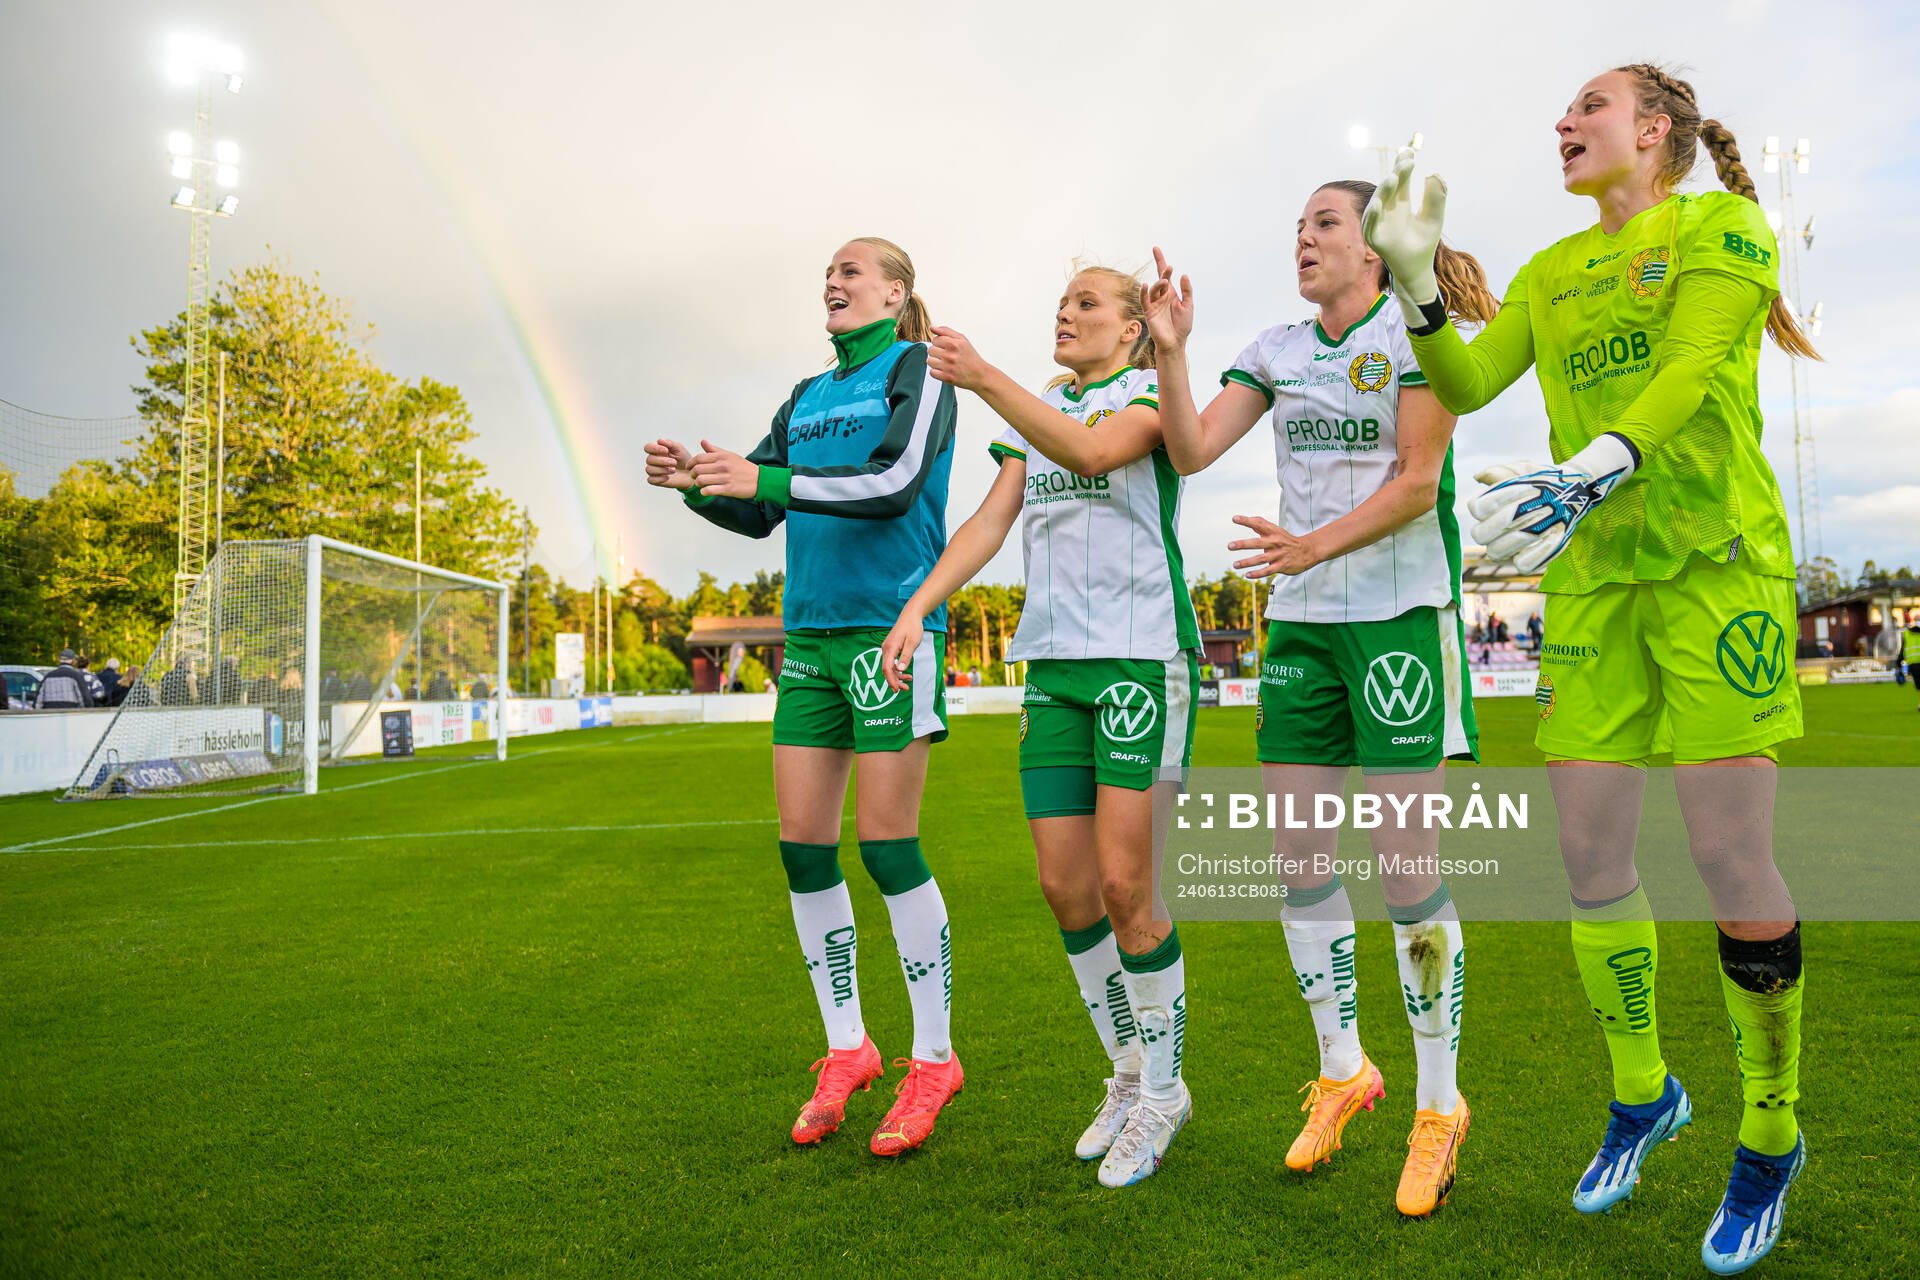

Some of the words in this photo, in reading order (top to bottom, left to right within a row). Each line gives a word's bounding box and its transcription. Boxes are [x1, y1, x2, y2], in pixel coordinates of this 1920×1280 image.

[1723, 232, 1771, 266] BST
[1564, 330, 1651, 381] ROJOB
[1315, 371, 1339, 381] NORDIC
[1603, 360, 1651, 380] WORKWEAR
[788, 416, 845, 447] CRAFT
[1286, 418, 1380, 443] PROJOB
[1292, 443, 1339, 452] PROFESSIONAL
[1026, 494, 1074, 506] PROFESSIONAL
[1074, 492, 1111, 501] WORKWEAR
[1541, 642, 1599, 657] SPHORUS
[864, 718, 895, 727] CRAFT
[1753, 704, 1779, 723] CRAFT
[204, 729, 262, 751] hässleholm
[1391, 735, 1427, 745] CRAFT
[1110, 751, 1142, 762] CRAFT
[825, 925, 857, 1002] Clinton
[1607, 947, 1652, 1030] Clinton
